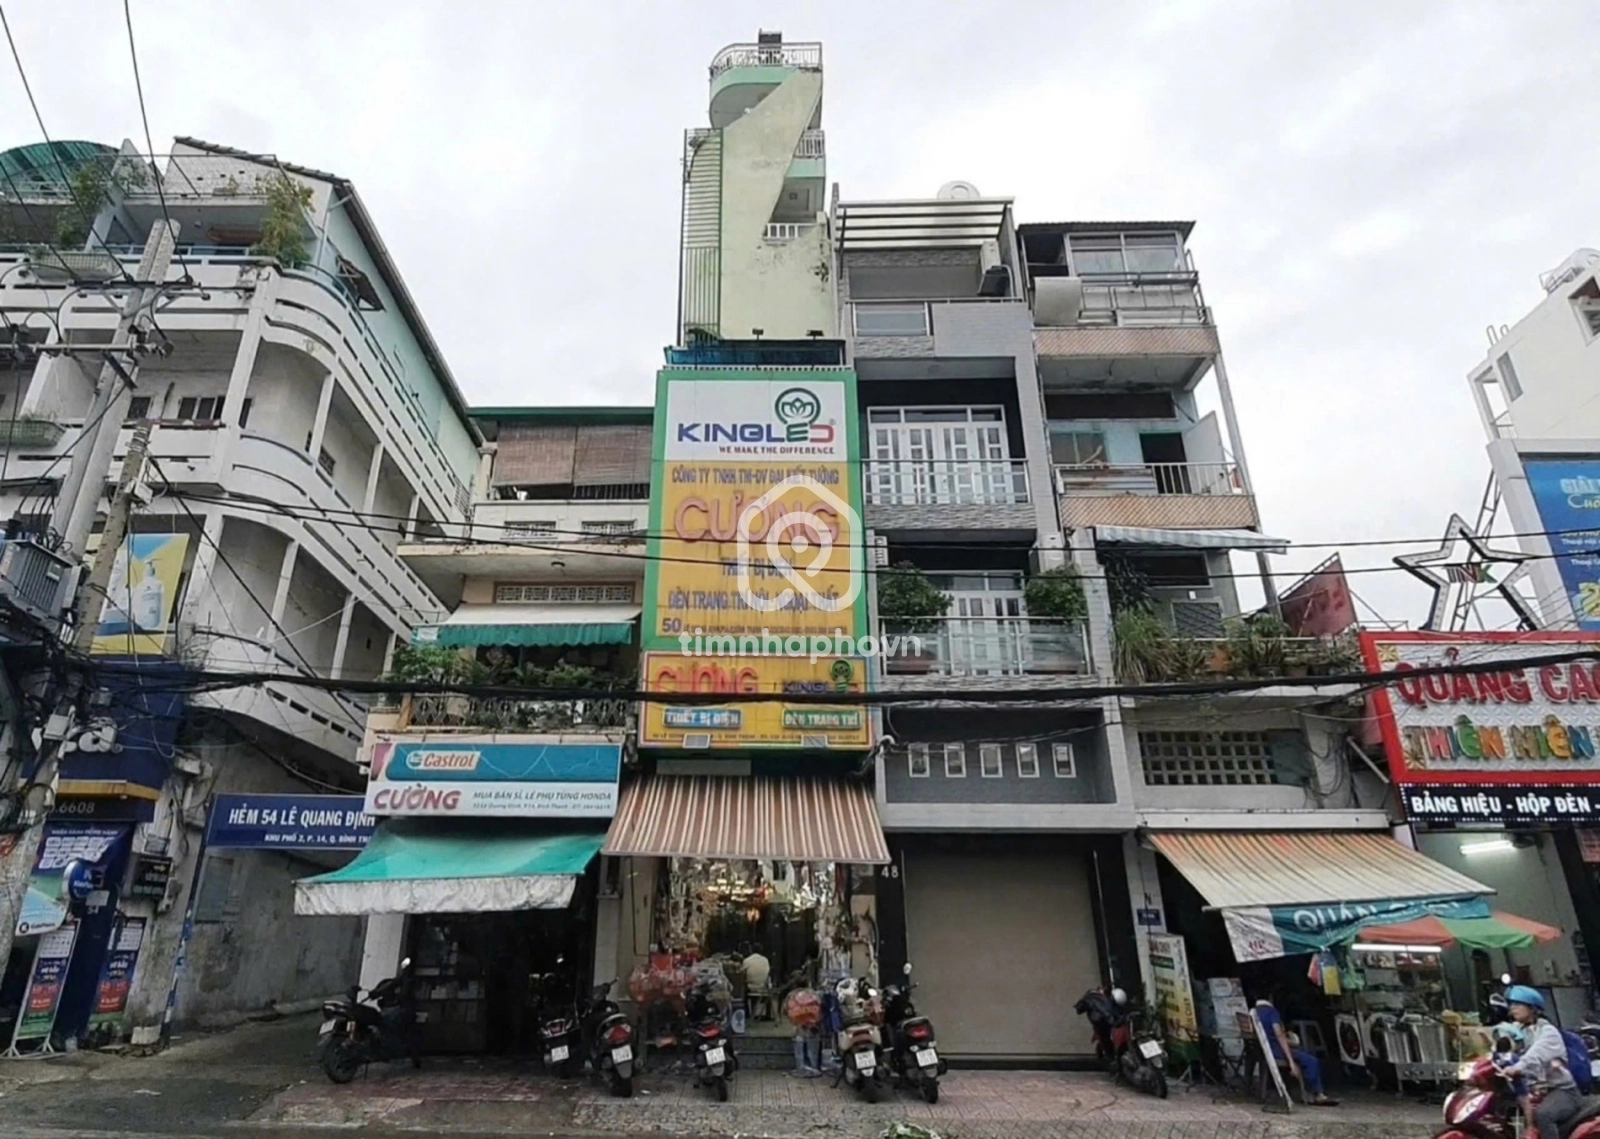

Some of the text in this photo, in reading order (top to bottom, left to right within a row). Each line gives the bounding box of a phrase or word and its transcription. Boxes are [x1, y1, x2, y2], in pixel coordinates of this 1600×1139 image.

[678, 422, 834, 443] KINGLED
[719, 446, 834, 454] WE MAKE THE DIFFERENCE
[662, 617, 682, 633] 50
[1394, 646, 1534, 709] QUẢNG
[1402, 714, 1596, 760] THIÊN NIÊN
[424, 752, 475, 769] Castrol
[374, 783, 462, 810] CƯỜNG
[581, 791, 611, 800] HONDA
[1411, 790, 1459, 813] BẢNG
[1460, 792, 1502, 816] HIỆU
[1515, 792, 1551, 816] HỘP
[1554, 791, 1591, 813] ĐÈN
[228, 803, 375, 830] HẺM 54 LÊ QUANG ĐỊNH
[264, 833, 280, 842] KHU
[282, 831, 297, 842] PHỐ
[339, 833, 357, 843] BÌNH
[881, 865, 899, 879] 48
